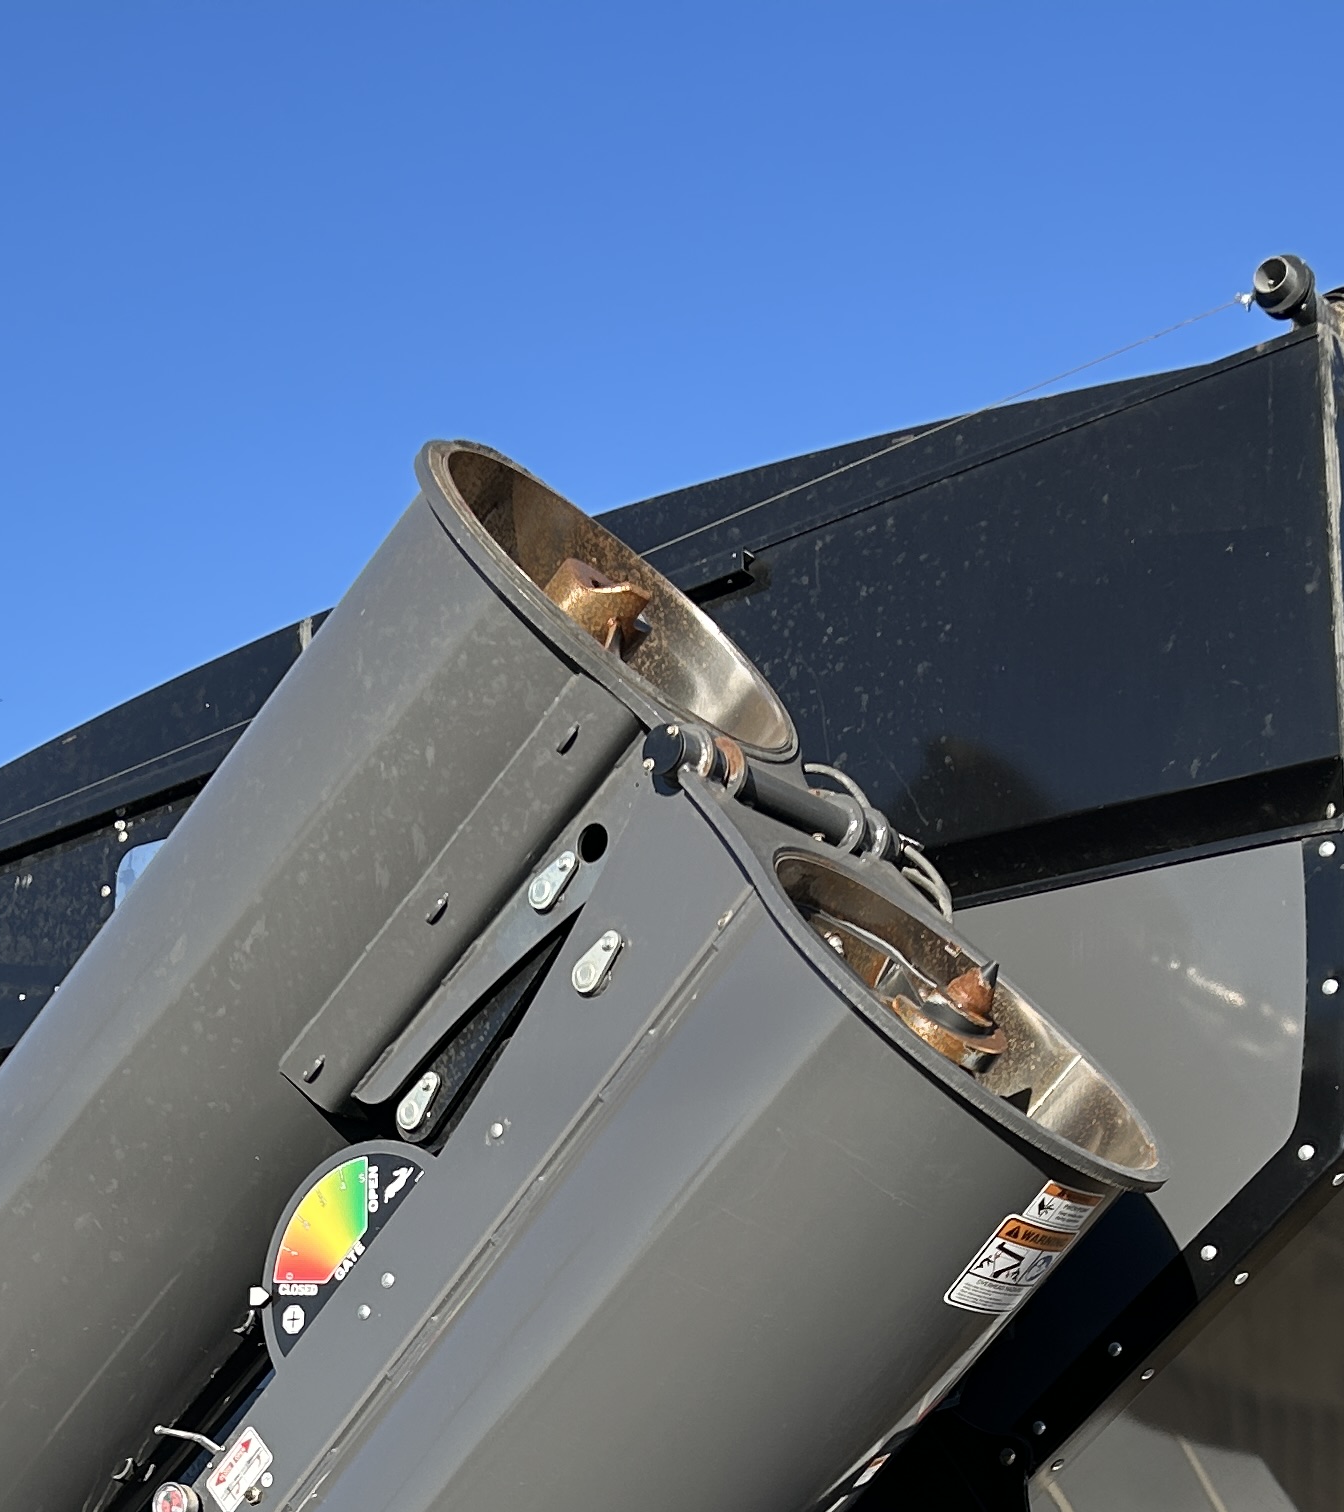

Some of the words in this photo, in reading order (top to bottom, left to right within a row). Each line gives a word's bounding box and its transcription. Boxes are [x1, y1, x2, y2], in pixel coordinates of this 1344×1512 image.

[368, 1166, 378, 1212] OPEN
[1022, 1230, 1068, 1248] WARNING
[334, 1241, 365, 1280] GATE
[278, 1284, 318, 1296] CLOSED
